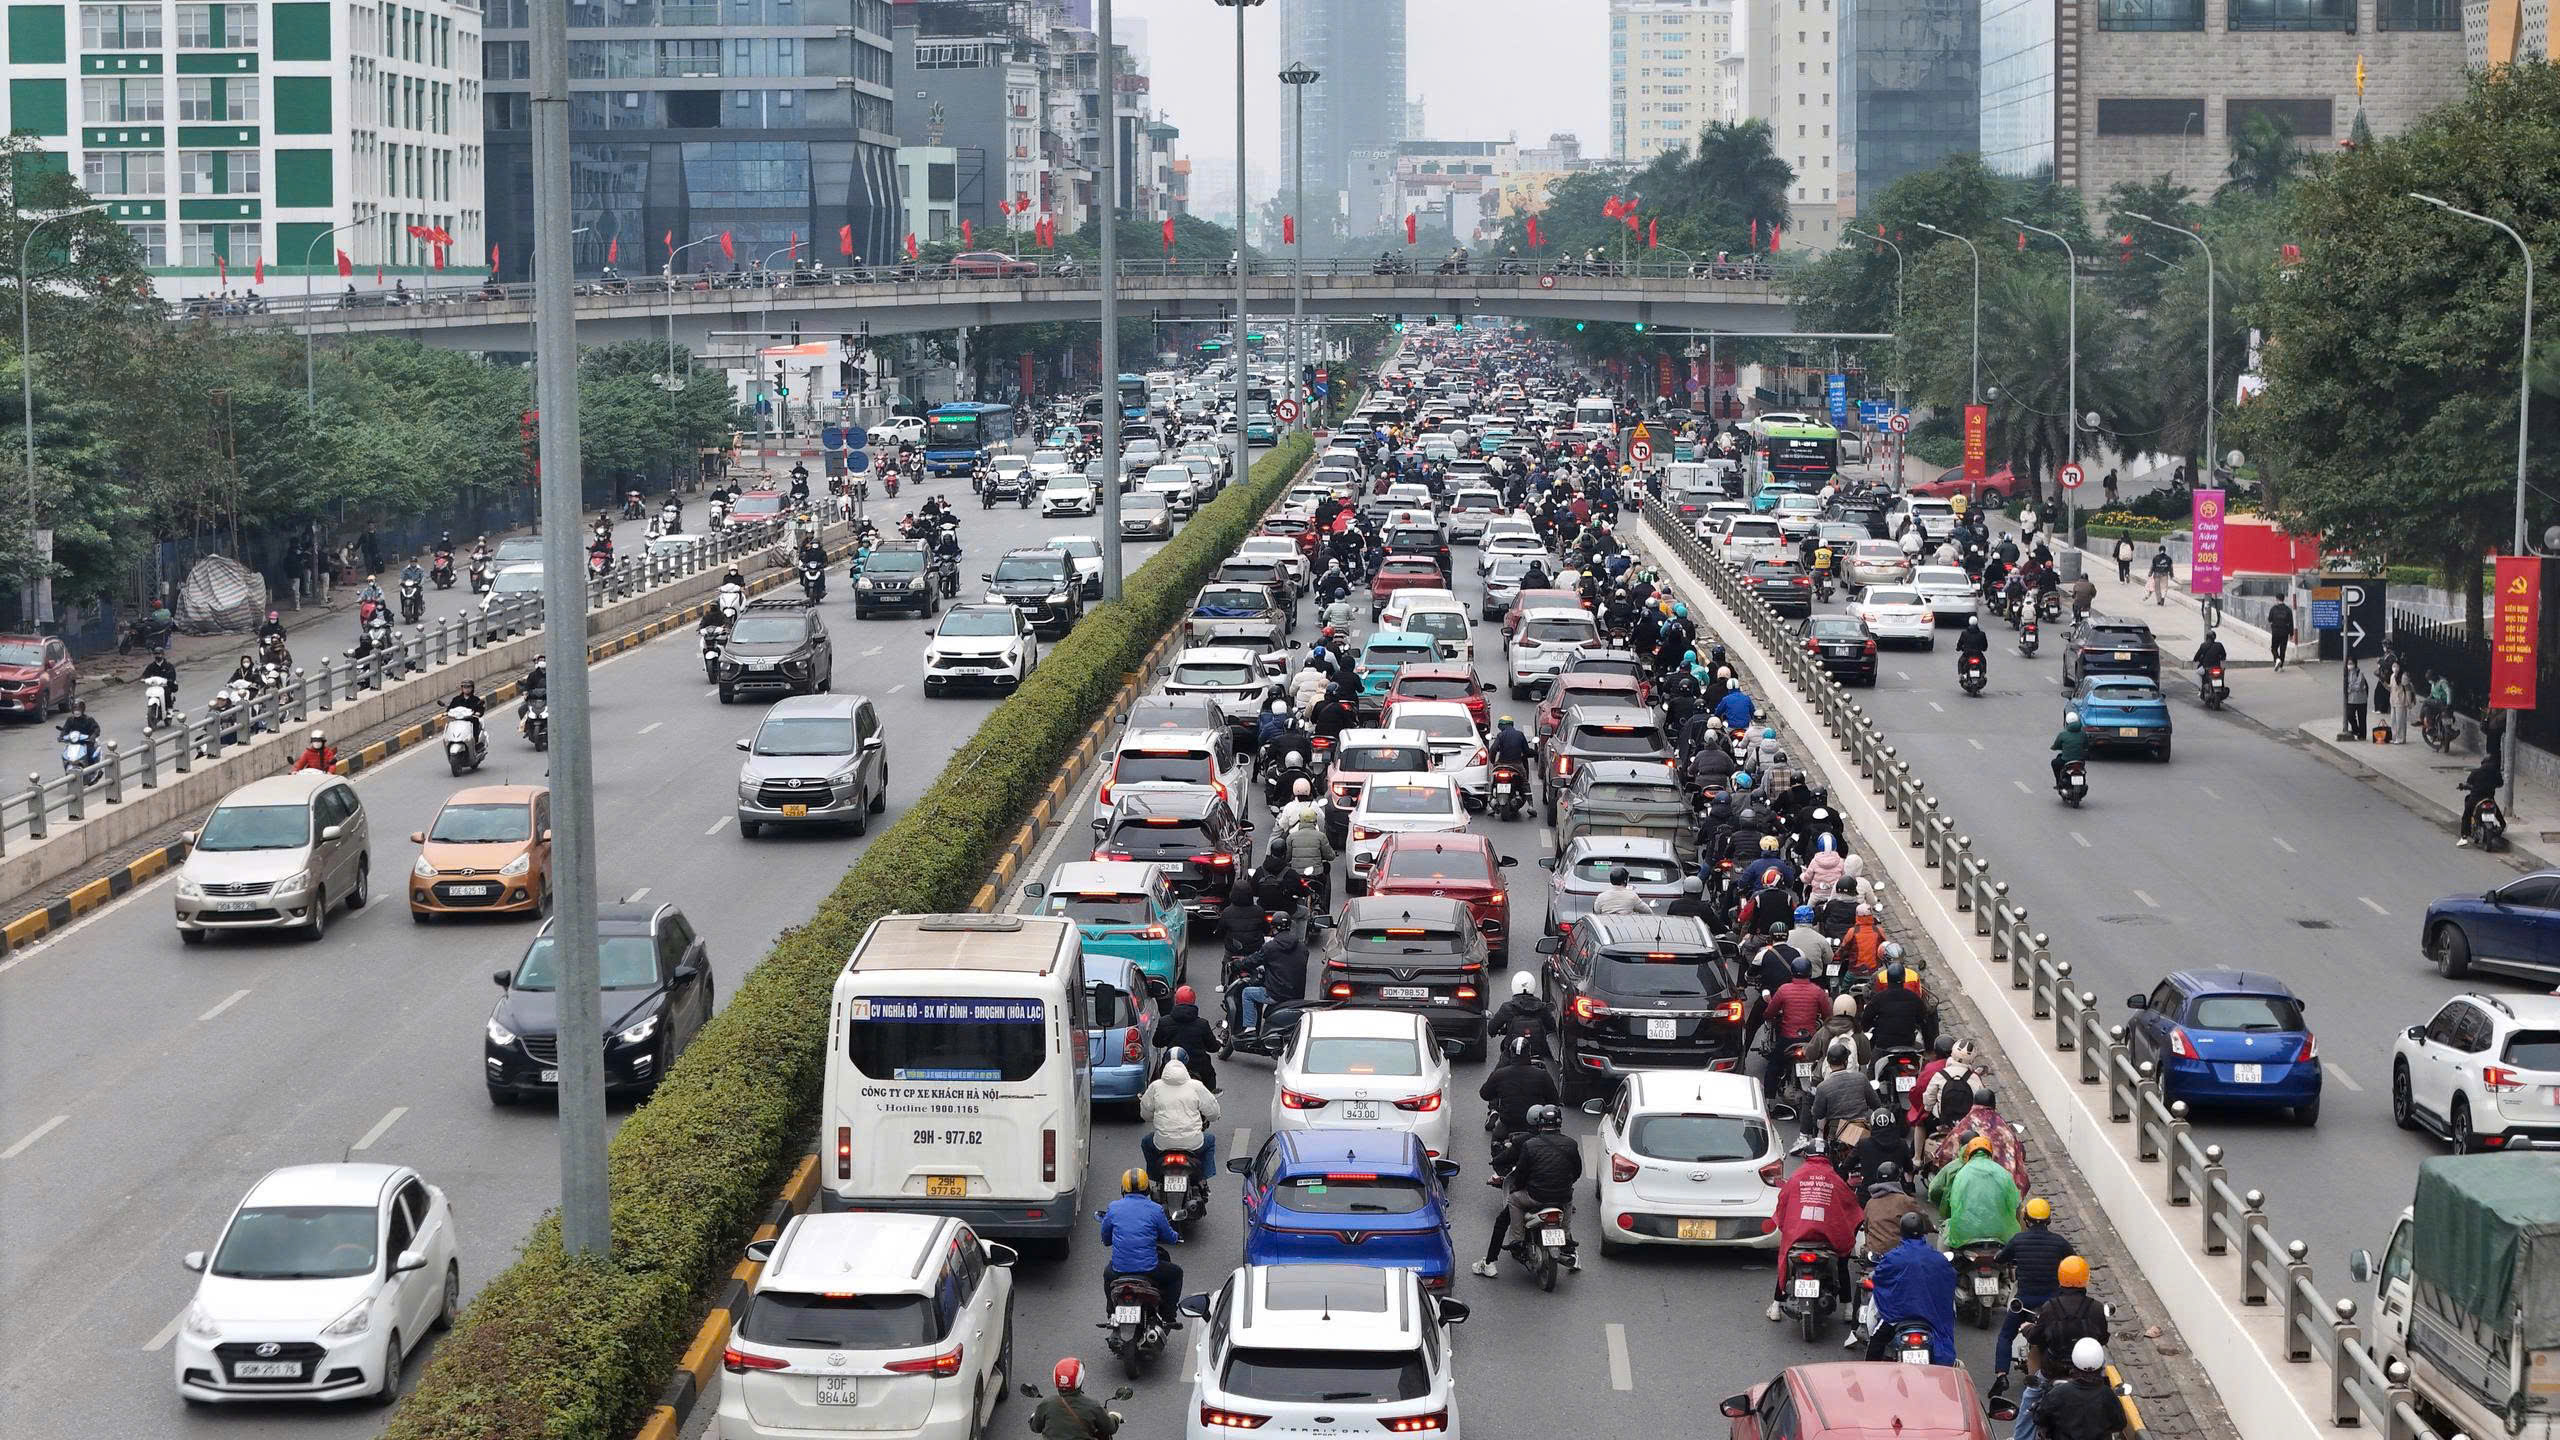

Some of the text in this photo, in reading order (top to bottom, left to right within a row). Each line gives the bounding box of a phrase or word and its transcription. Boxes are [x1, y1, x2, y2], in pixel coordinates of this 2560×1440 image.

[853, 1003, 869, 1016] 71
[871, 1004, 881, 1017] CV
[882, 1002, 906, 1018] NGHĨA
[907, 1002, 918, 1018] ĐÔ
[924, 1005, 935, 1018] BX
[936, 1003, 949, 1019] MỸ
[949, 1003, 968, 1019] ĐÌNH
[974, 1006, 1005, 1020] ĐHQGHN
[1007, 1003, 1025, 1020] (HÒA
[1026, 1006, 1044, 1022] LẠC)
[1654, 1020, 1670, 1029] 30G
[861, 1087, 999, 1102] CÔNG TY CP XE KHÁCH HÀ NỘI
[885, 1104, 979, 1114] Hotline 1900.1165
[1353, 1101, 1369, 1110] 30K
[913, 1130, 935, 1145] 29H
[945, 1131, 983, 1145] 977.62
[937, 1177, 956, 1187] 29H
[931, 1186, 962, 1196] 977.62
[827, 1377, 848, 1390] 30F
[818, 1391, 856, 1404] 984.48
